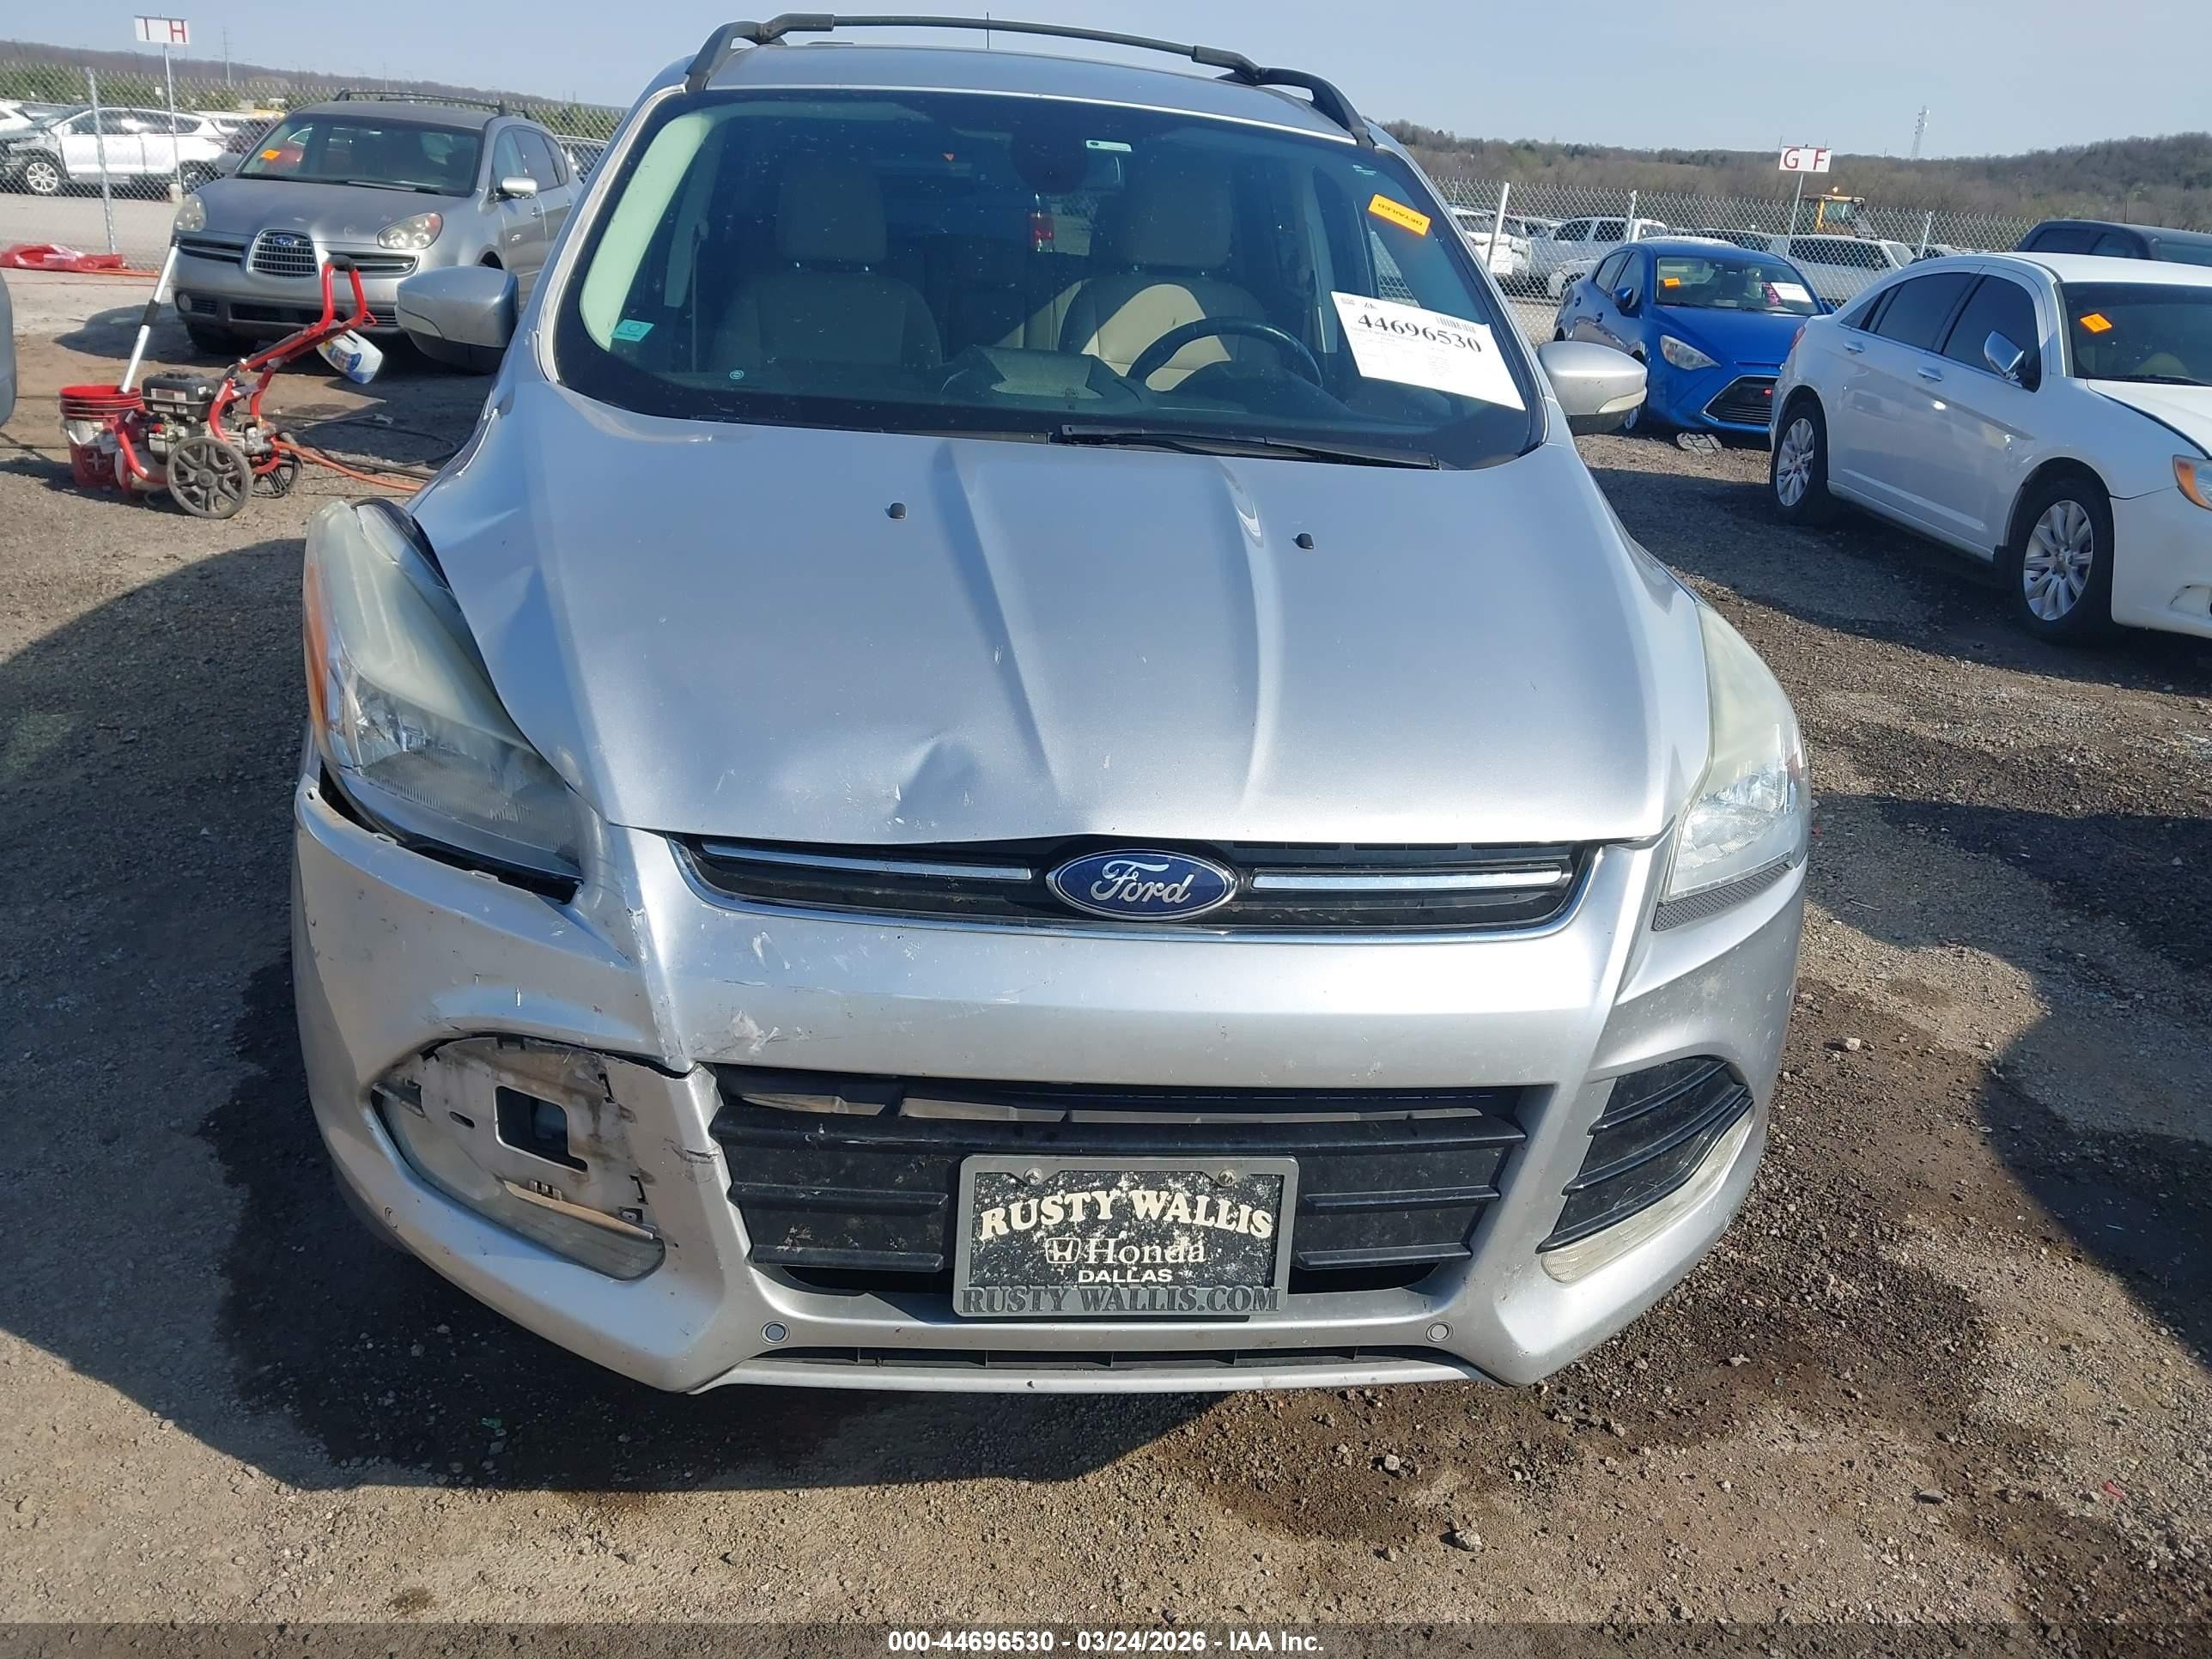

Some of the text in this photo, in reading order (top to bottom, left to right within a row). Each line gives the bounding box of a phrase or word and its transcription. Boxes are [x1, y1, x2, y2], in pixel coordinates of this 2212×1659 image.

[168, 19, 186, 43] H
[1784, 148, 1827, 171] G F
[1358, 313, 1483, 354] 44696530
[1090, 860, 1196, 904] Ford
[978, 1189, 1273, 1242] RUSTY WALLIS
[1084, 1237, 1207, 1264] Honda
[1078, 1268, 1174, 1283] DALLAS
[961, 1285, 1281, 1313] RUSTY WALLIS.COM
